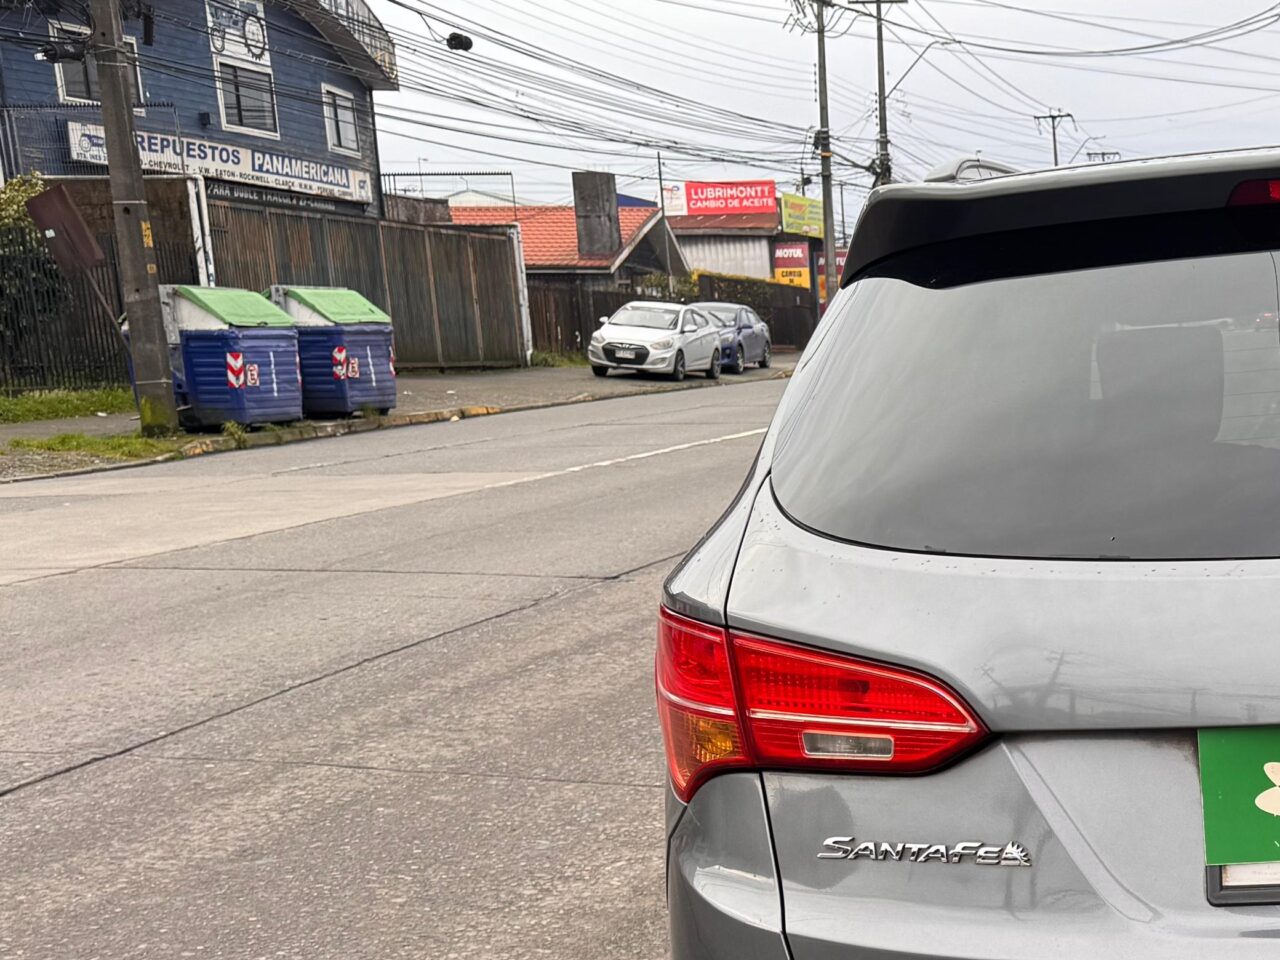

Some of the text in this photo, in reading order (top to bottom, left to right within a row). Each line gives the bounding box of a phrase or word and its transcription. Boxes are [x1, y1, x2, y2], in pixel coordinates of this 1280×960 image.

[136, 134, 349, 187] REPUESTOS PANAMERICANA
[149, 160, 190, 172] CHEVROLT
[215, 167, 236, 178] EATON
[239, 172, 271, 184] ROCKWELL
[689, 198, 774, 209] CAMBIO DE ACEITE
[775, 248, 803, 258] MOTUL
